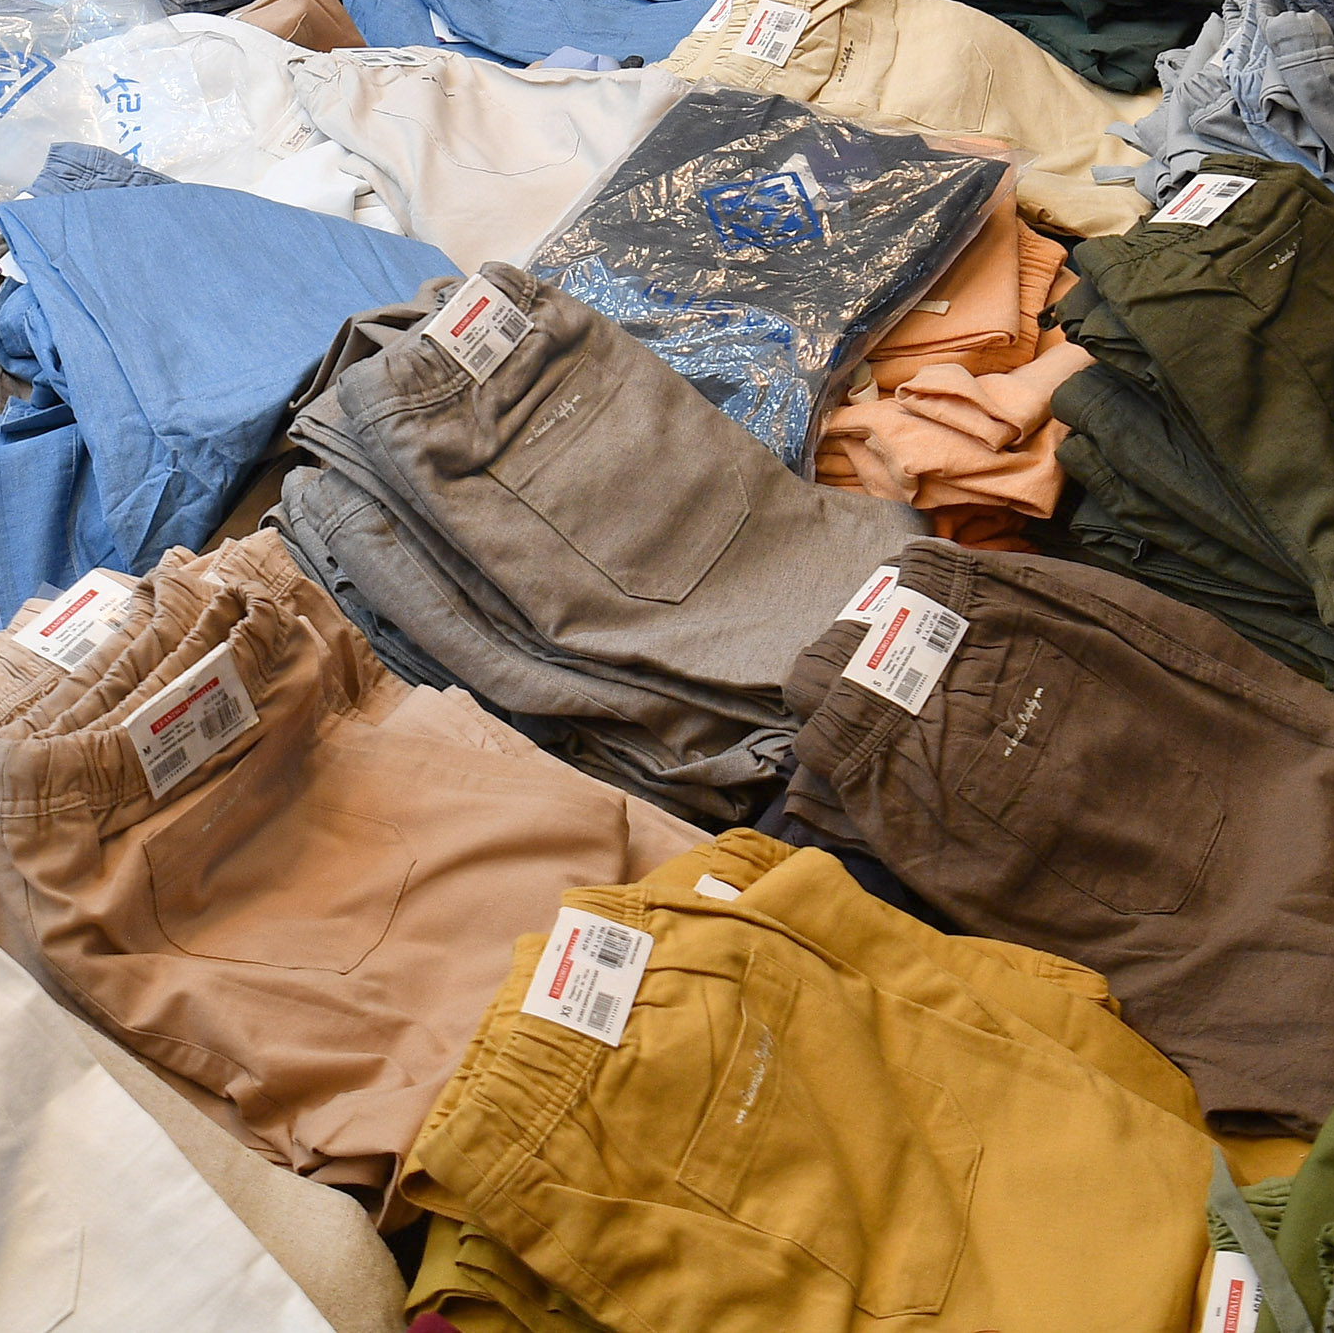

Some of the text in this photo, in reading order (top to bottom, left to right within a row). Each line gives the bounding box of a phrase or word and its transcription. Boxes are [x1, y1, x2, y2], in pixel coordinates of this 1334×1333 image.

[870, 638, 891, 667] LEANDRO
[872, 680, 882, 688] S
[142, 746, 152, 757] M
[560, 1004, 573, 1018] XS
